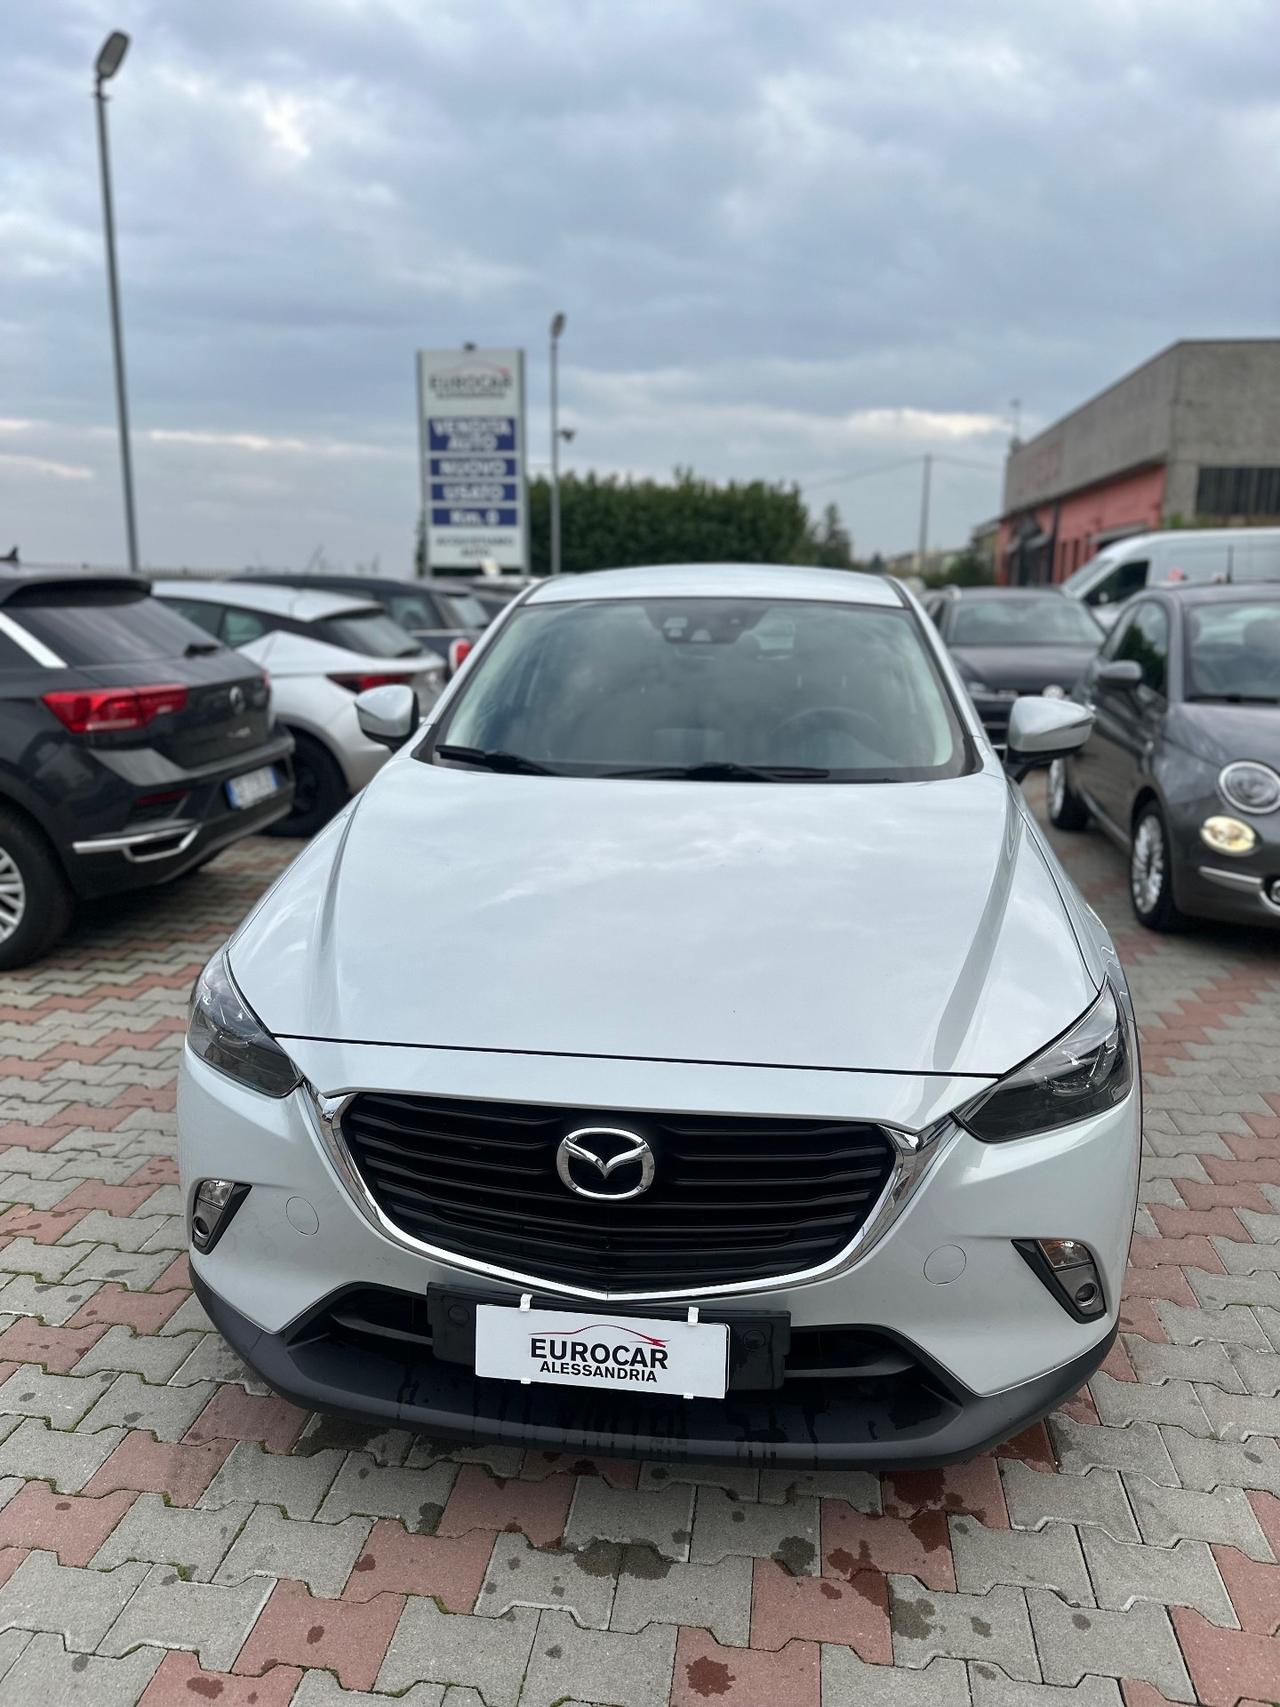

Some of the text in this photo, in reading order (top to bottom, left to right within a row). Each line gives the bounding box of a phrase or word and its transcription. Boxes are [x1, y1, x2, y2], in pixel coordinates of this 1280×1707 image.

[429, 374, 512, 389] EUROCAR
[432, 418, 511, 435] VENDITA
[447, 435, 498, 450] AUTO
[440, 459, 506, 475] NUOVO
[442, 484, 504, 500] USATO
[531, 1338, 668, 1369] EUROCAR
[540, 1361, 657, 1382] ALESSANDRIA
